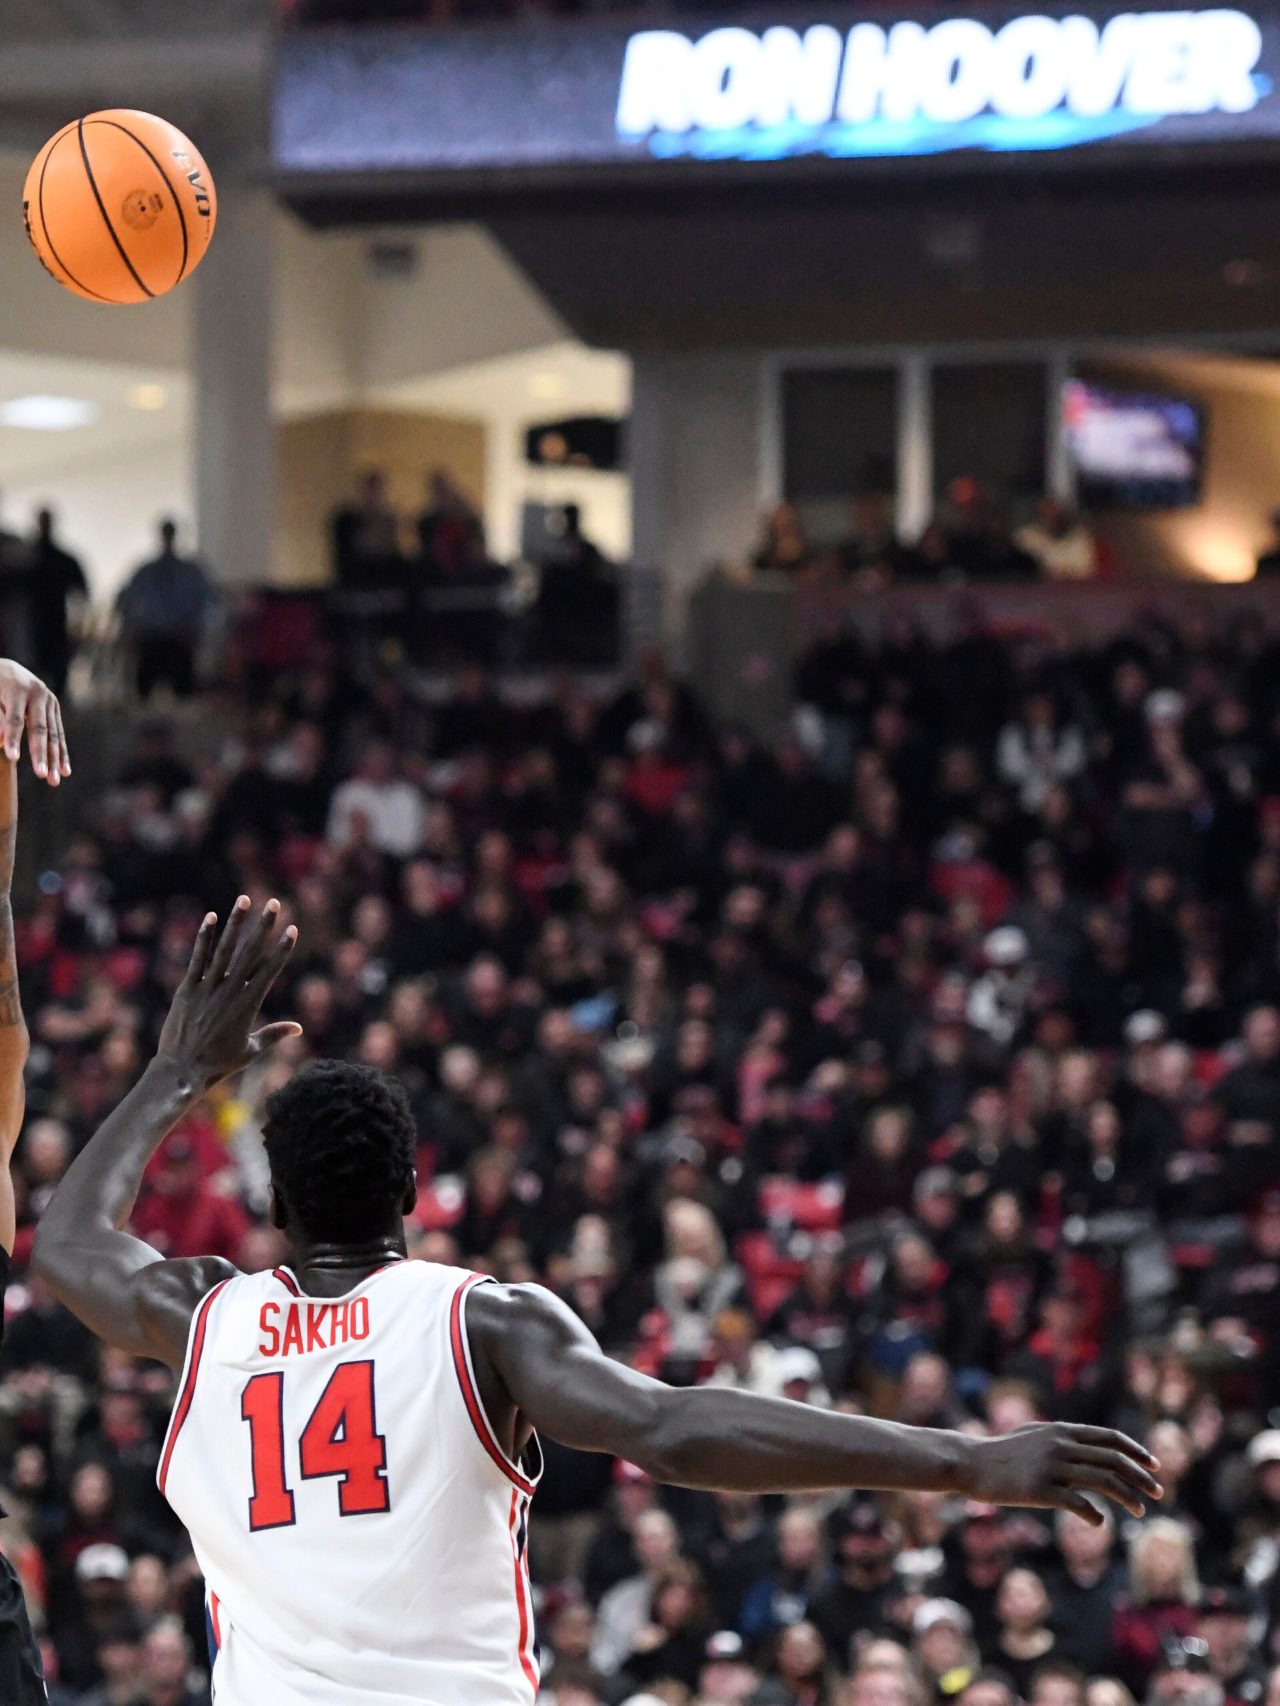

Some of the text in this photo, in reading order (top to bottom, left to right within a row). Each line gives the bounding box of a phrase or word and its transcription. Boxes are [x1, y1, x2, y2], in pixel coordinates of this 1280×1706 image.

[617, 9, 1262, 131] RON HOOVER
[258, 1296, 370, 1357] SAKHO
[240, 1359, 391, 1532] 14
